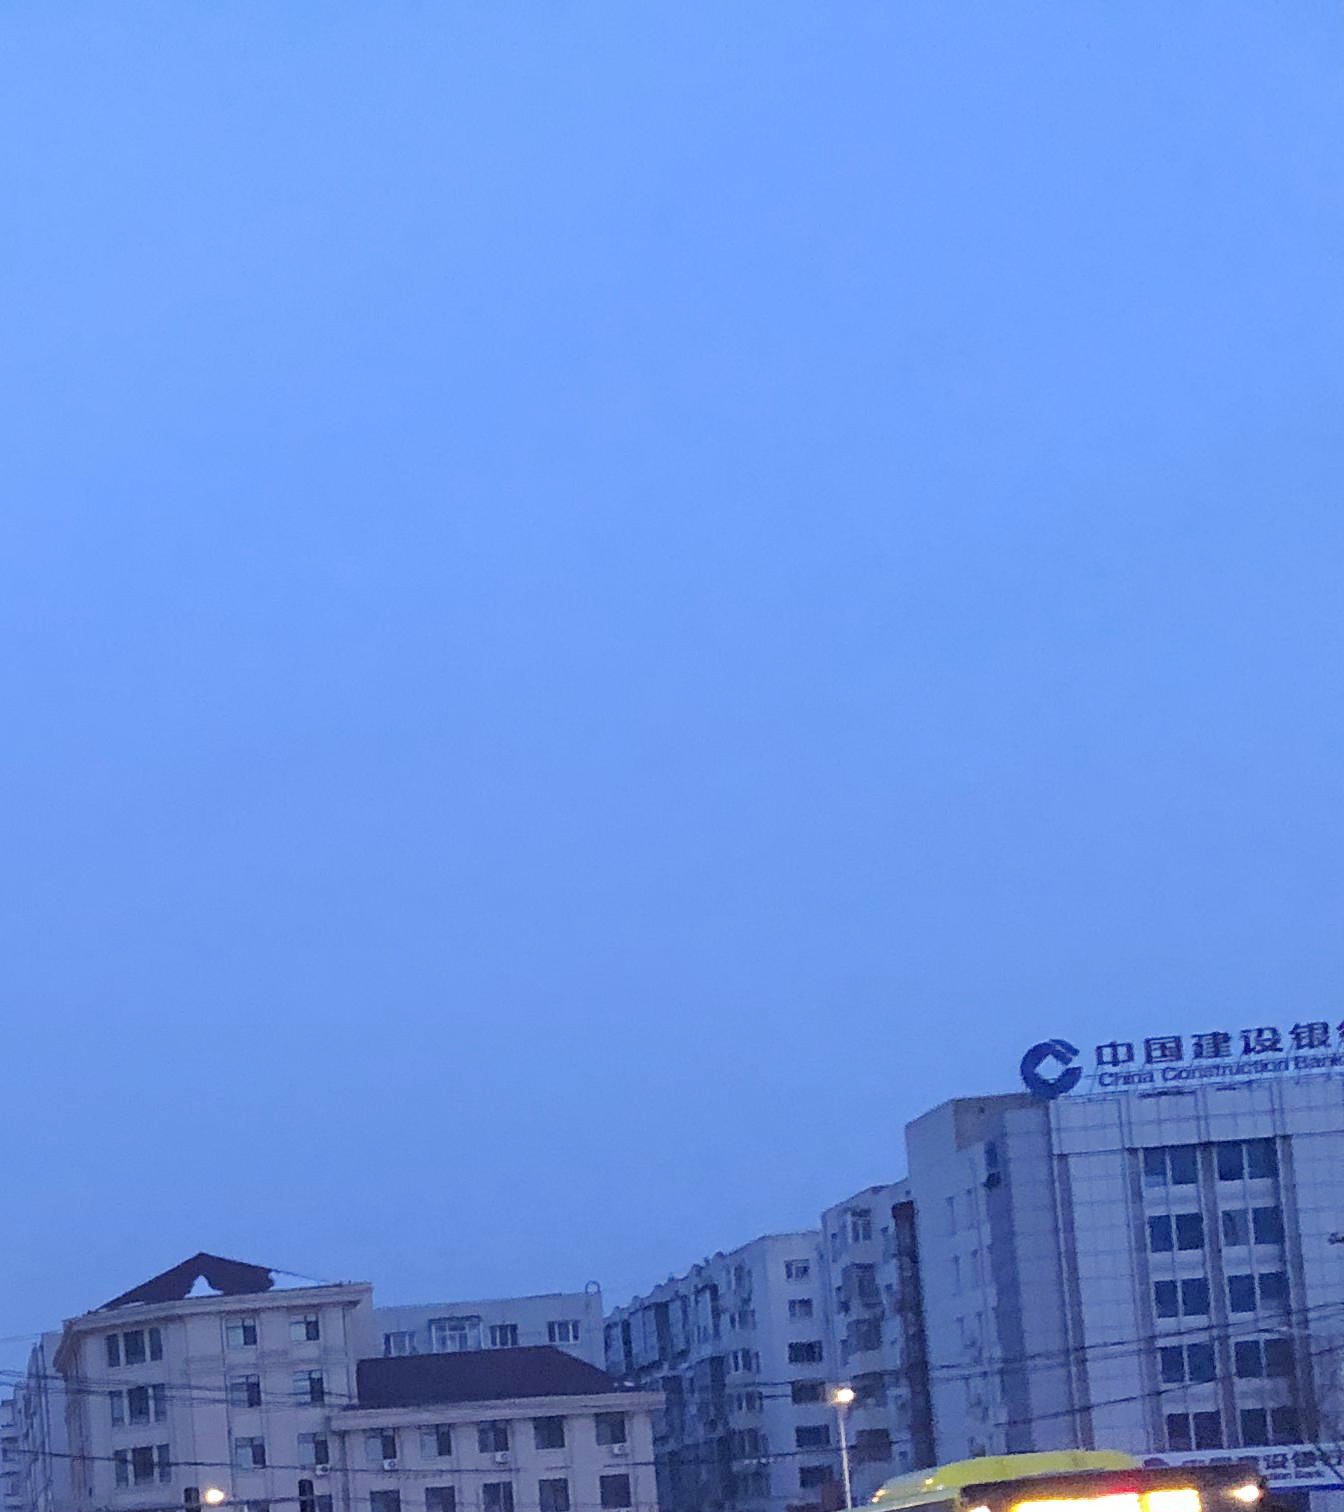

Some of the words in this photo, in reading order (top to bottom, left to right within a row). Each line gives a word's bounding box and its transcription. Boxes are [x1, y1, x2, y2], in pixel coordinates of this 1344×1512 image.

[1095, 1020, 1344, 1067] 中国建设银
[1098, 1070, 1155, 1088] China
[1162, 1057, 1289, 1082] Construction
